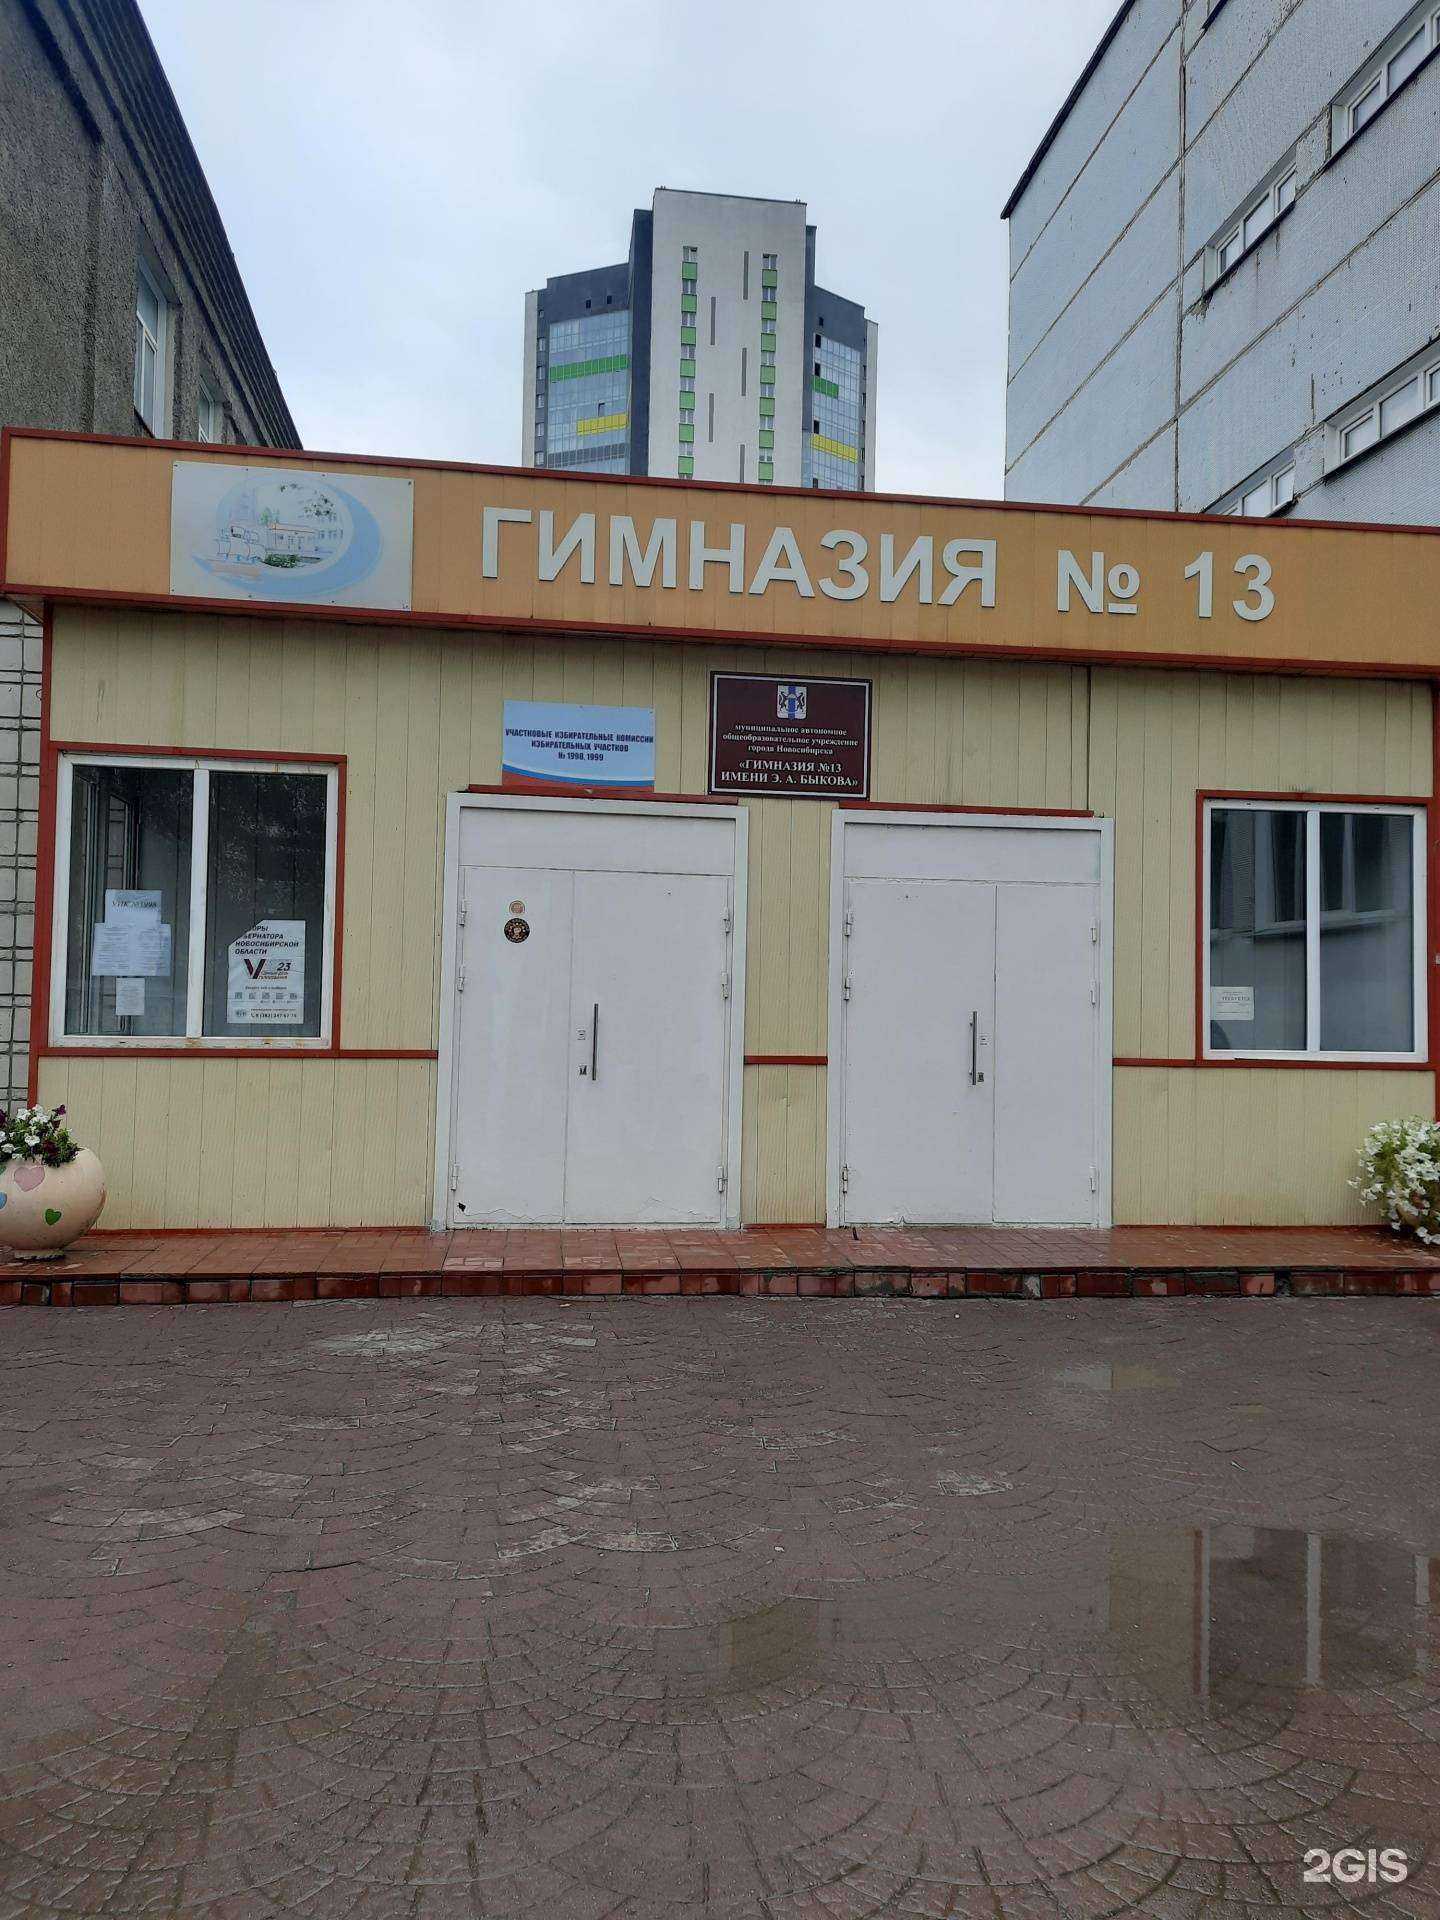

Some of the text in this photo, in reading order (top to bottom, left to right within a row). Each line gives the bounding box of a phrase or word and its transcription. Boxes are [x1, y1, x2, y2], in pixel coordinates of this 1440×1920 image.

[482, 506, 1276, 621] ГИМНАЗИЯ № 13
[505, 728, 654, 744] УЧАСТКОВЫЕ ИЗБИРАТЕЛЬНЫЕ КОМИССИИ
[735, 724, 847, 736] муниципальное автономное
[531, 740, 629, 752] ИЗБИРАТЕЛЬНЫХ УЧАСТКОВ
[722, 732, 859, 747] общеобразовательное учреждение
[748, 745, 833, 756] города Новосибирска
[739, 759, 842, 773] «ГИМНАЗИЯ №13
[721, 771, 858, 786] ИМЕНИ Э. А. БЫКОВА»
